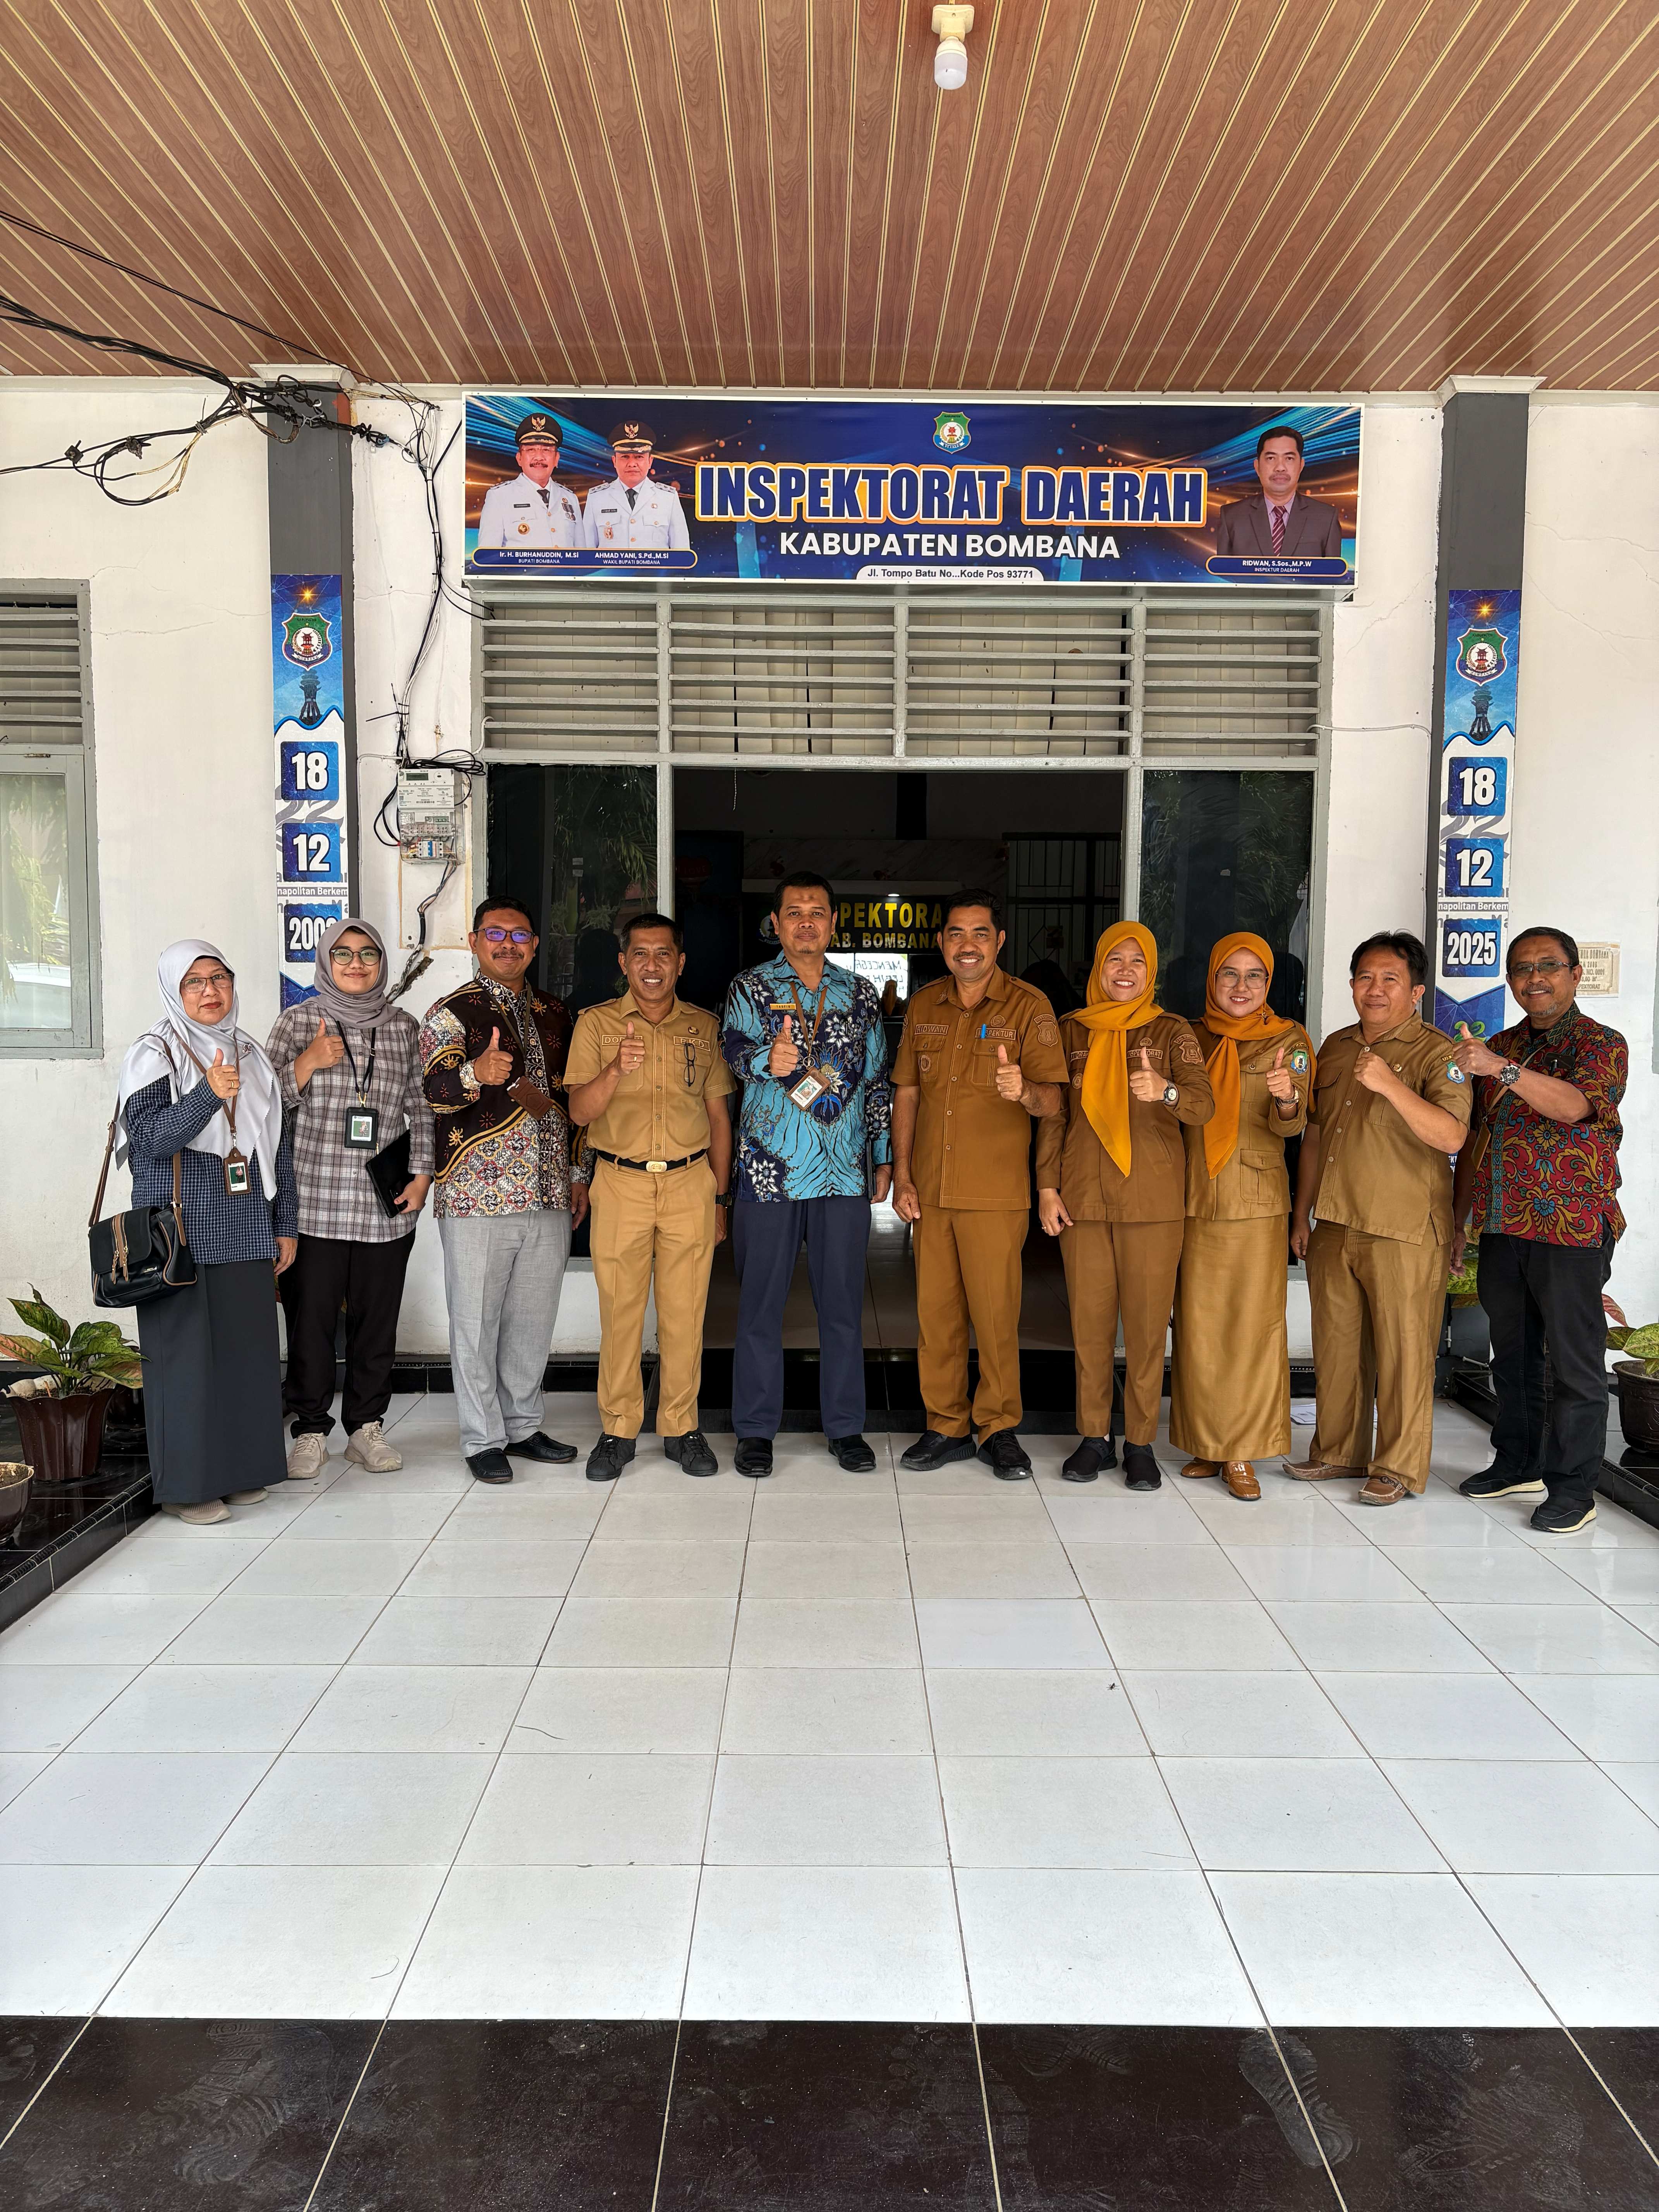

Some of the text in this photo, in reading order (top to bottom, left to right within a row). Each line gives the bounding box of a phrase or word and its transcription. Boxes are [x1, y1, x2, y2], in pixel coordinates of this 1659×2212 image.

[698, 464, 1204, 524] INSPEKTORAT DAERAH
[781, 532, 1120, 558] KABUPATEN BOMBANA
[881, 569, 912, 579] Tompo
[915, 569, 936, 577] Batu
[987, 570, 1004, 578] Pos
[292, 752, 328, 790] 18
[1459, 768, 1495, 805] 18
[293, 834, 330, 871] 12
[1456, 849, 1493, 886] 12
[830, 933, 855, 948] AB.
[1447, 932, 1496, 965] 2025
[917, 1025, 946, 1034] RIDWAN
